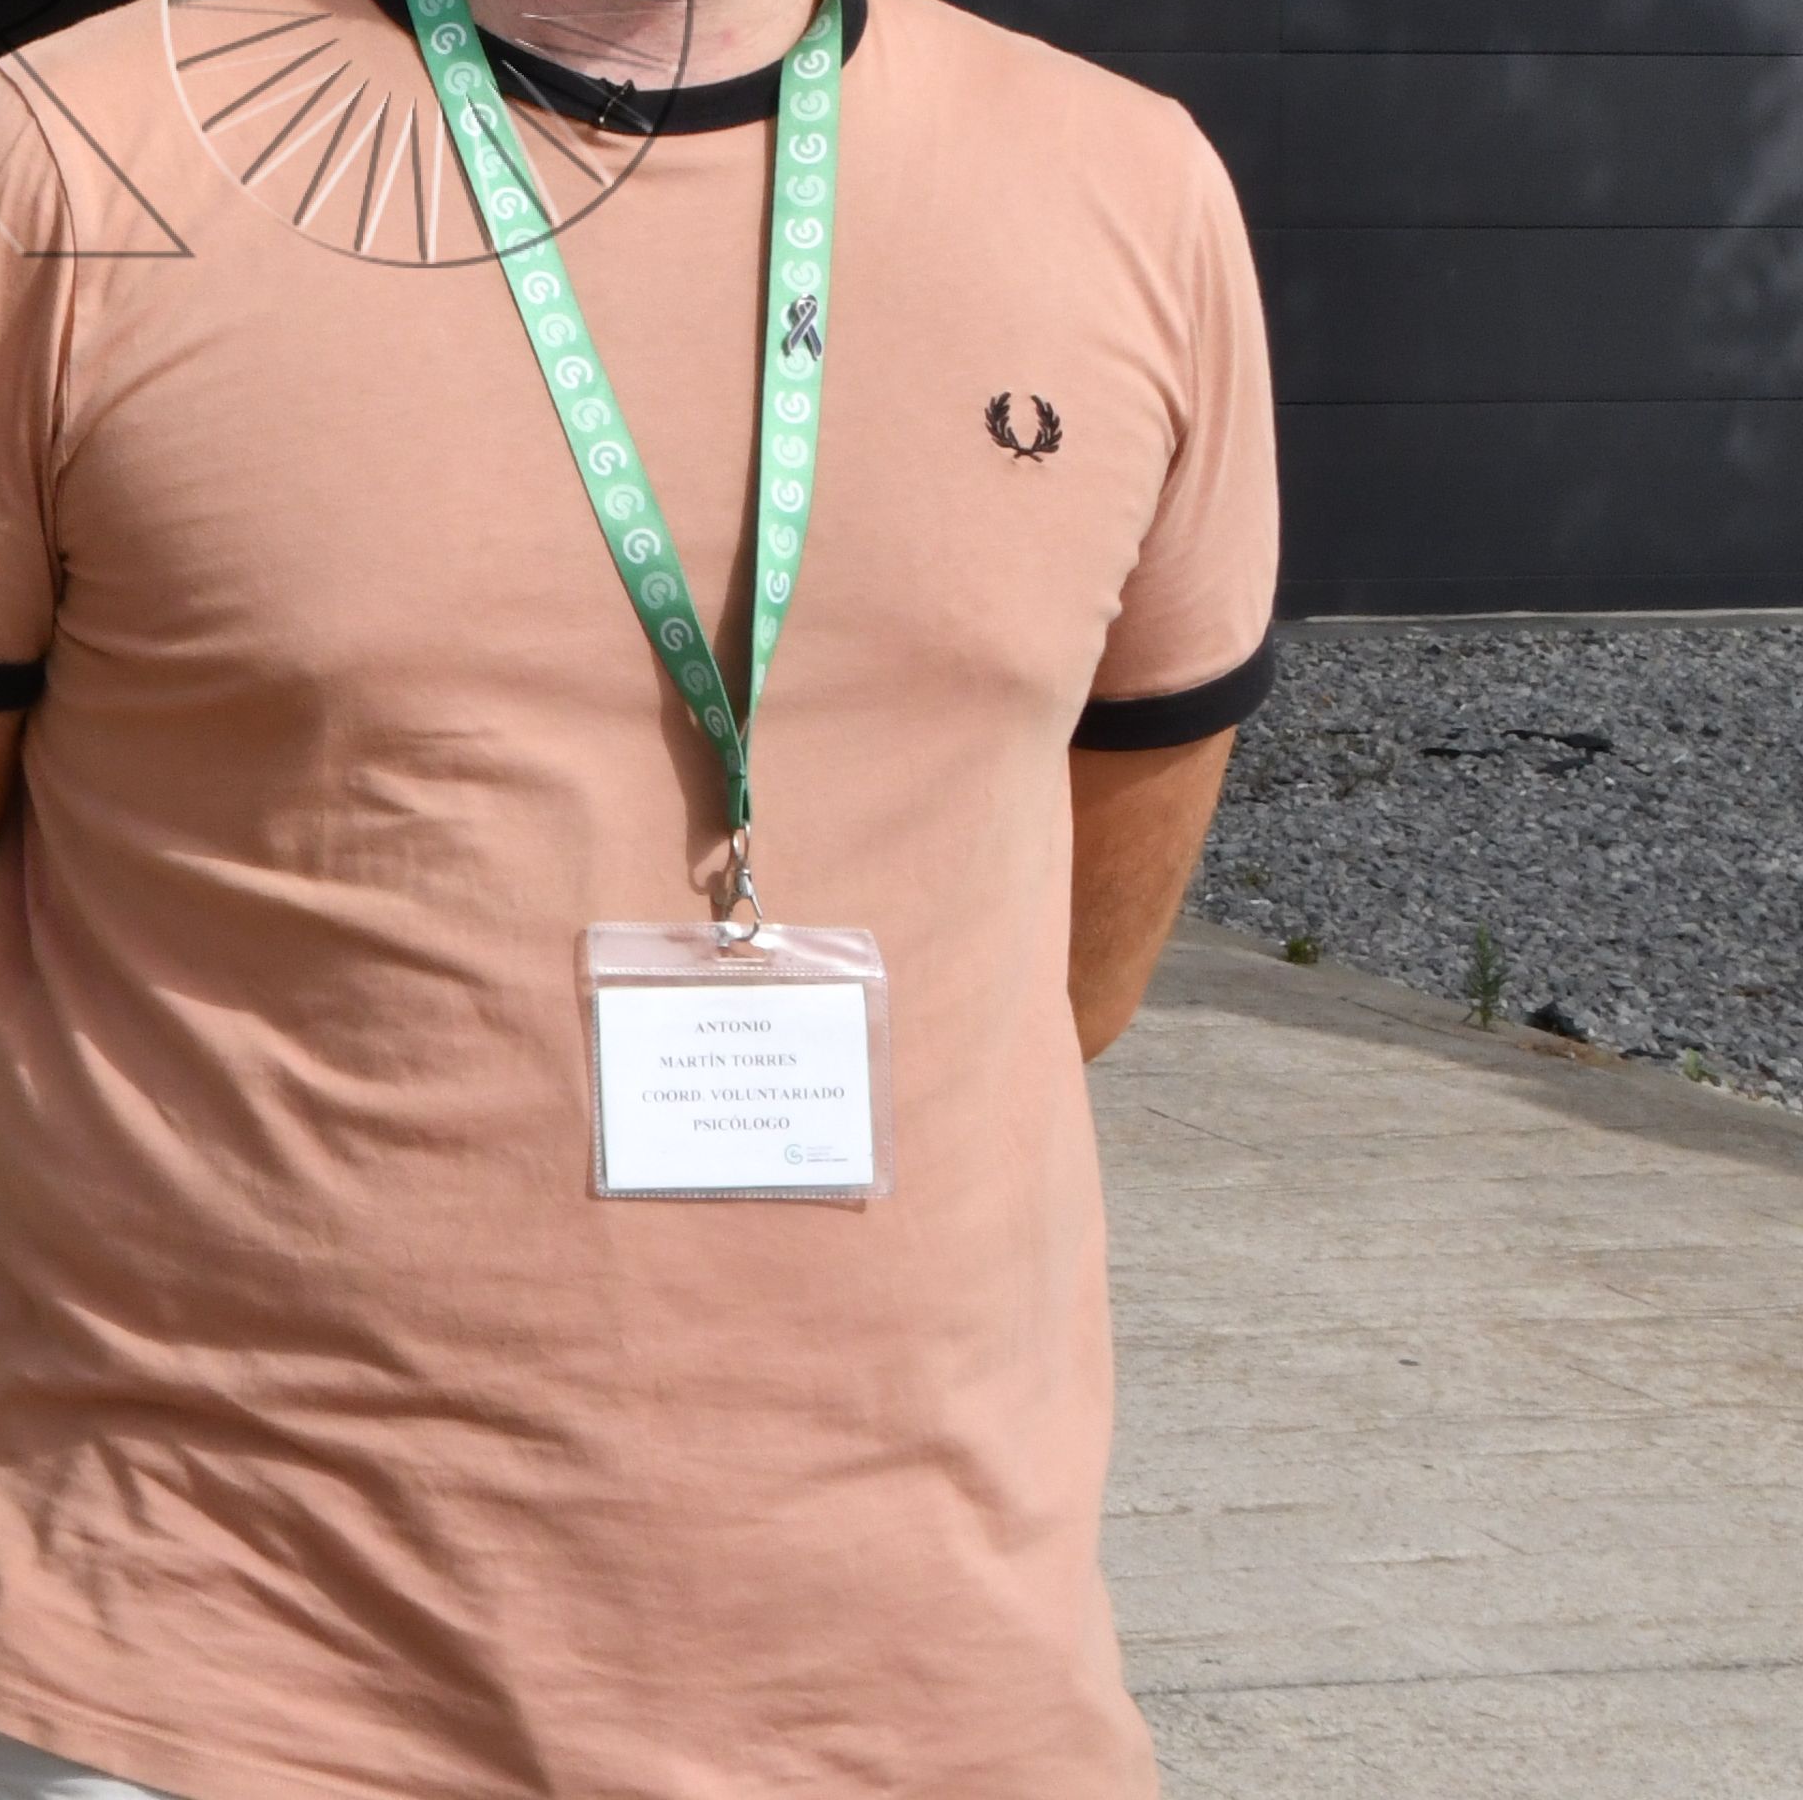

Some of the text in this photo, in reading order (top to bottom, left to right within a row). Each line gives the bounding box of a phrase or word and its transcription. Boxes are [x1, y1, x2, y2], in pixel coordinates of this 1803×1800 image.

[694, 1019, 772, 1034] ANTONIO
[659, 1050, 798, 1069] MARTÍN TORRES
[641, 1085, 846, 1104] COORD. VOLUNTARIADO
[692, 1113, 791, 1132] PSICÓLOGO
